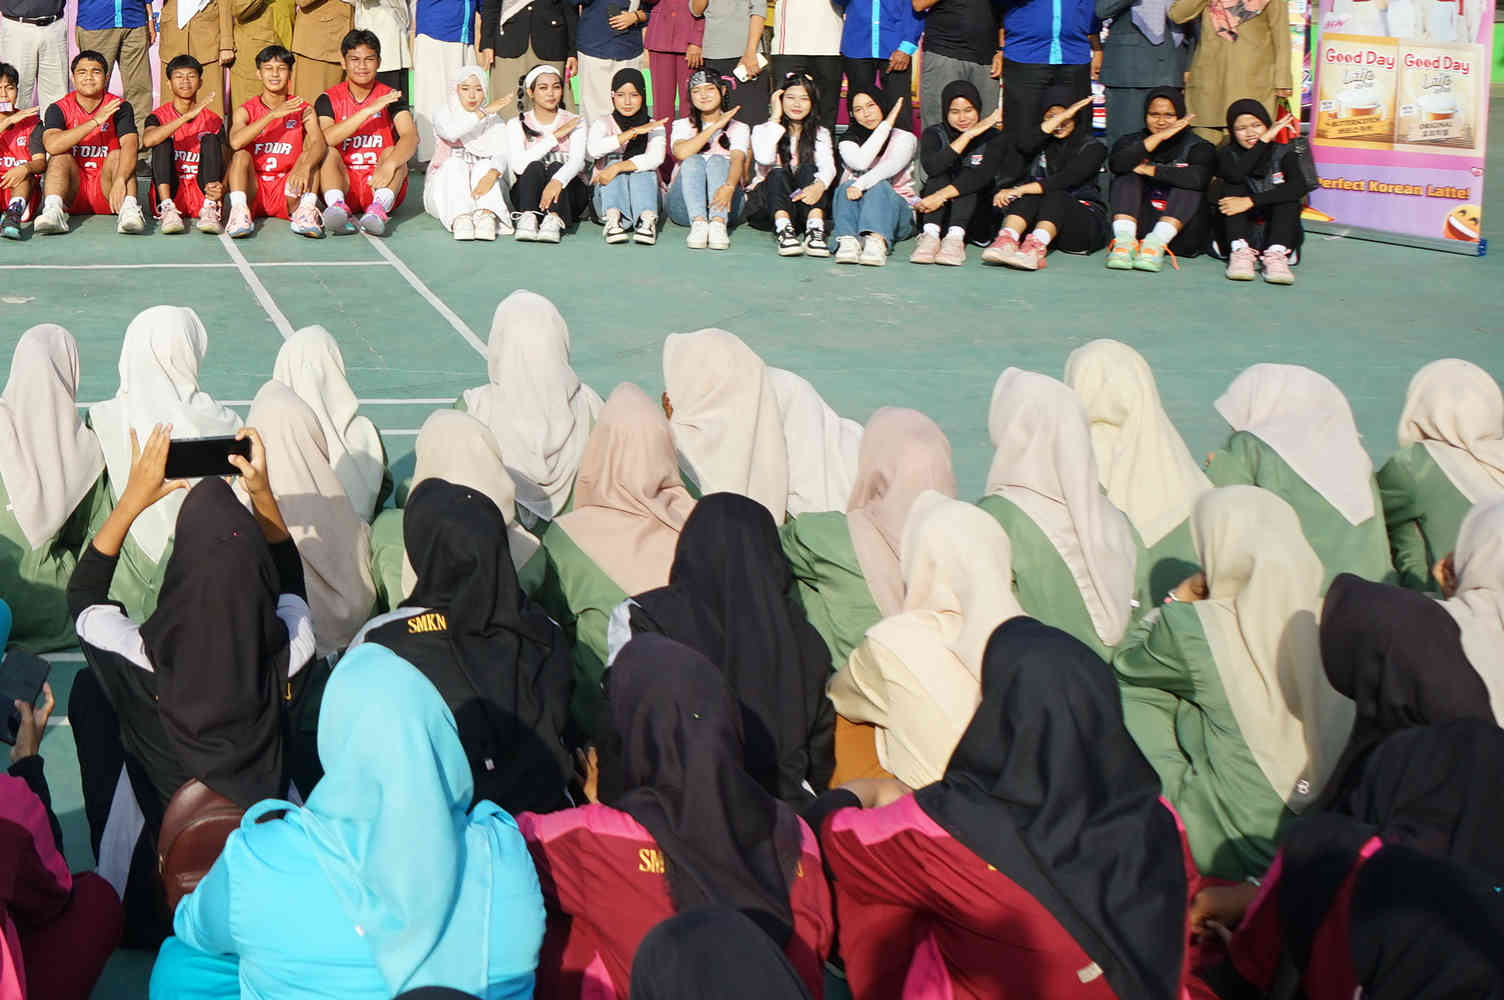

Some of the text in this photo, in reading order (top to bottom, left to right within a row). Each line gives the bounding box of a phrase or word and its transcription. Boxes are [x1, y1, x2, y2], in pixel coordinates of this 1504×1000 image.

[1325, 47, 1396, 70] Good Day
[1404, 53, 1470, 75] Good Day
[254, 142, 293, 155] FOUR
[342, 134, 384, 150] FOUR
[72, 145, 109, 158] FOUR
[265, 157, 278, 172] 2
[1369, 180, 1424, 196] Korean
[408, 613, 448, 634] SMKN
